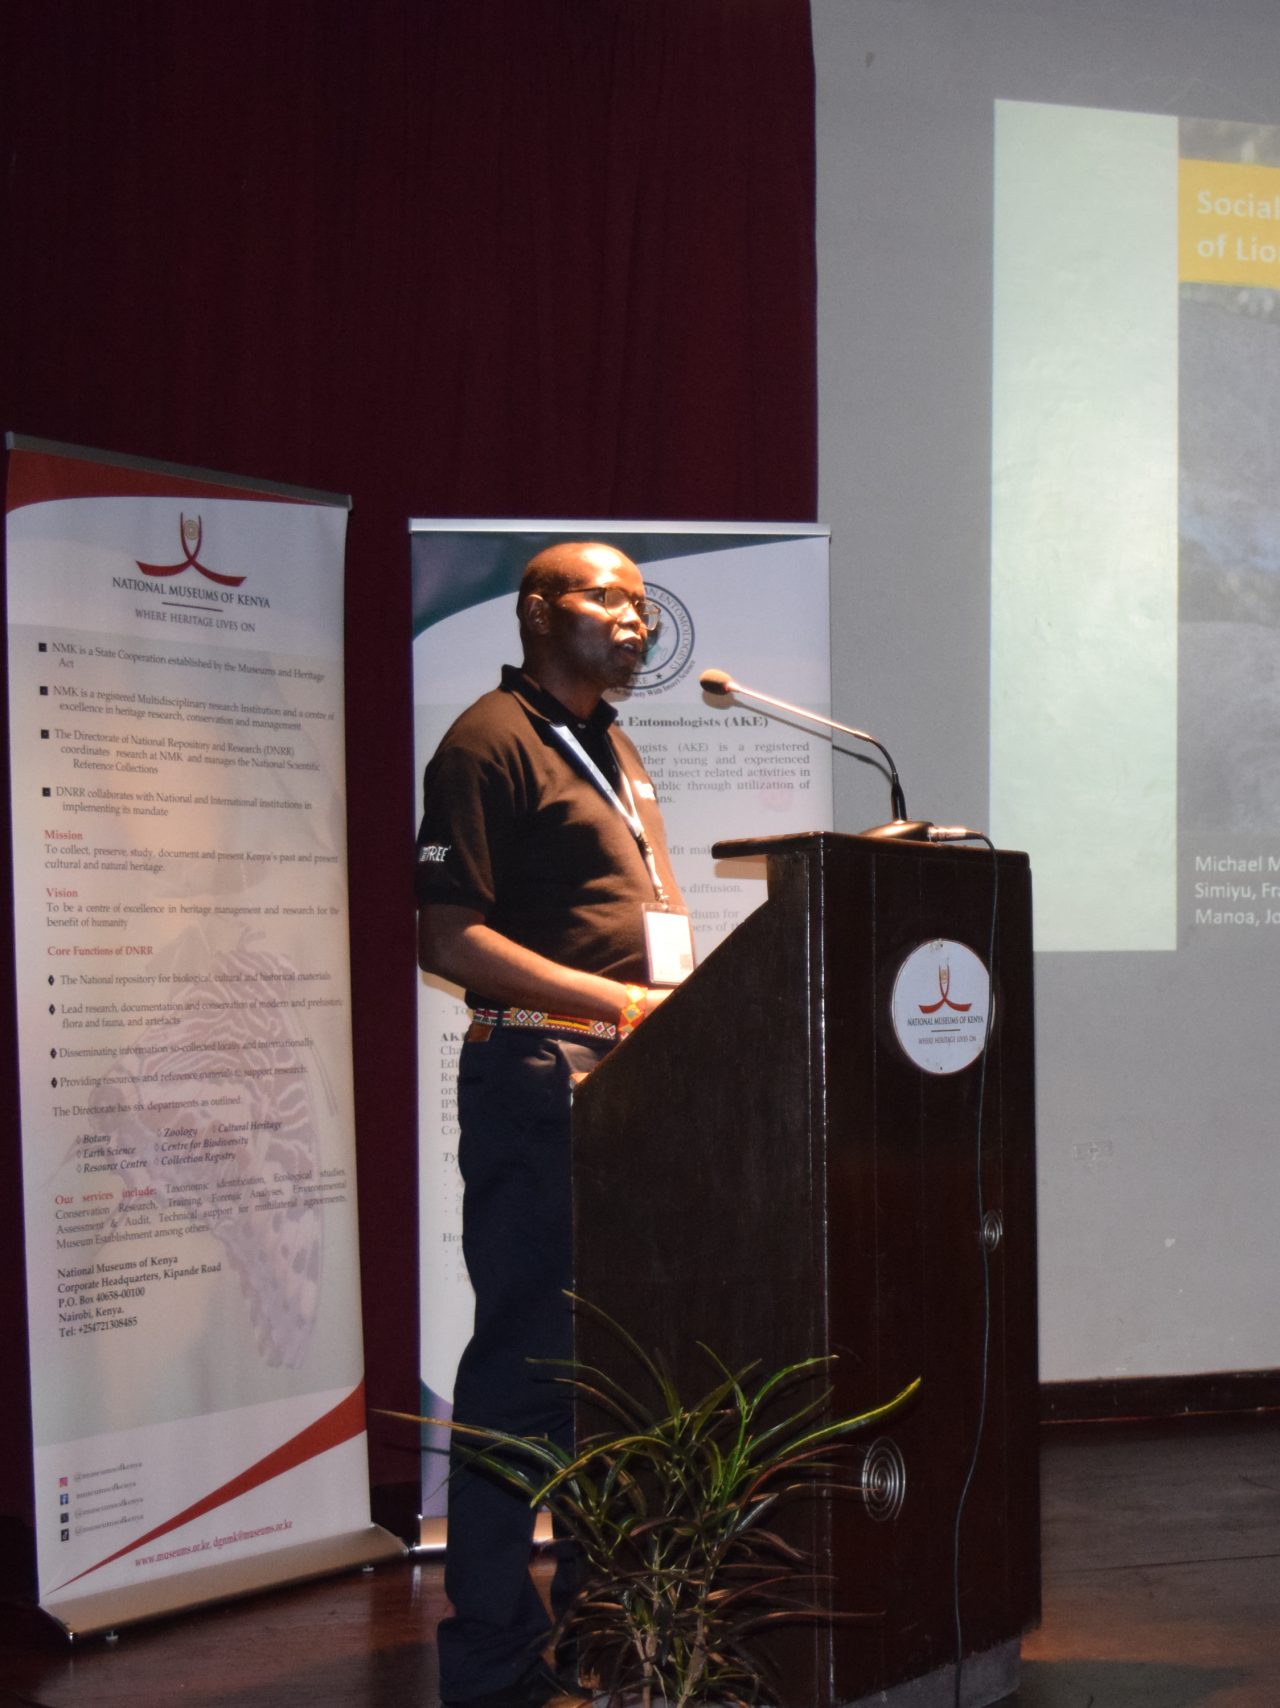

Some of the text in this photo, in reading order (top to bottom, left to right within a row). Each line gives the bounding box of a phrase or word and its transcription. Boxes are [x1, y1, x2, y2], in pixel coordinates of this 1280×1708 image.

[1196, 190, 1280, 221] Social
[1196, 233, 1228, 258] of
[112, 576, 271, 609] NATIONAL MUSEUMS OF KENYA
[135, 608, 256, 632] WHERE HERITAGE LIVES ON
[628, 716, 769, 729] Entomologists (AKE)
[677, 743, 709, 752] (AKE)
[719, 742, 728, 752] is
[738, 744, 745, 752] a
[755, 742, 810, 753] registered
[673, 756, 708, 766] young
[715, 755, 737, 765] and
[744, 755, 810, 766] experienced
[668, 768, 701, 778] insect
[704, 768, 743, 778] related
[747, 768, 796, 778] activities
[800, 768, 811, 778] in
[687, 780, 732, 792] through
[737, 780, 794, 791] utilization
[799, 780, 811, 791] of
[1195, 856, 1262, 873] Michael
[689, 882, 743, 894] diffusion.
[1194, 882, 1256, 902] Simiyu,
[1195, 908, 1260, 927] Manoa,
[57, 1255, 178, 1279] National Museums of Kenya
[57, 1262, 222, 1294] Corporate Headquarters, Kipande Road
